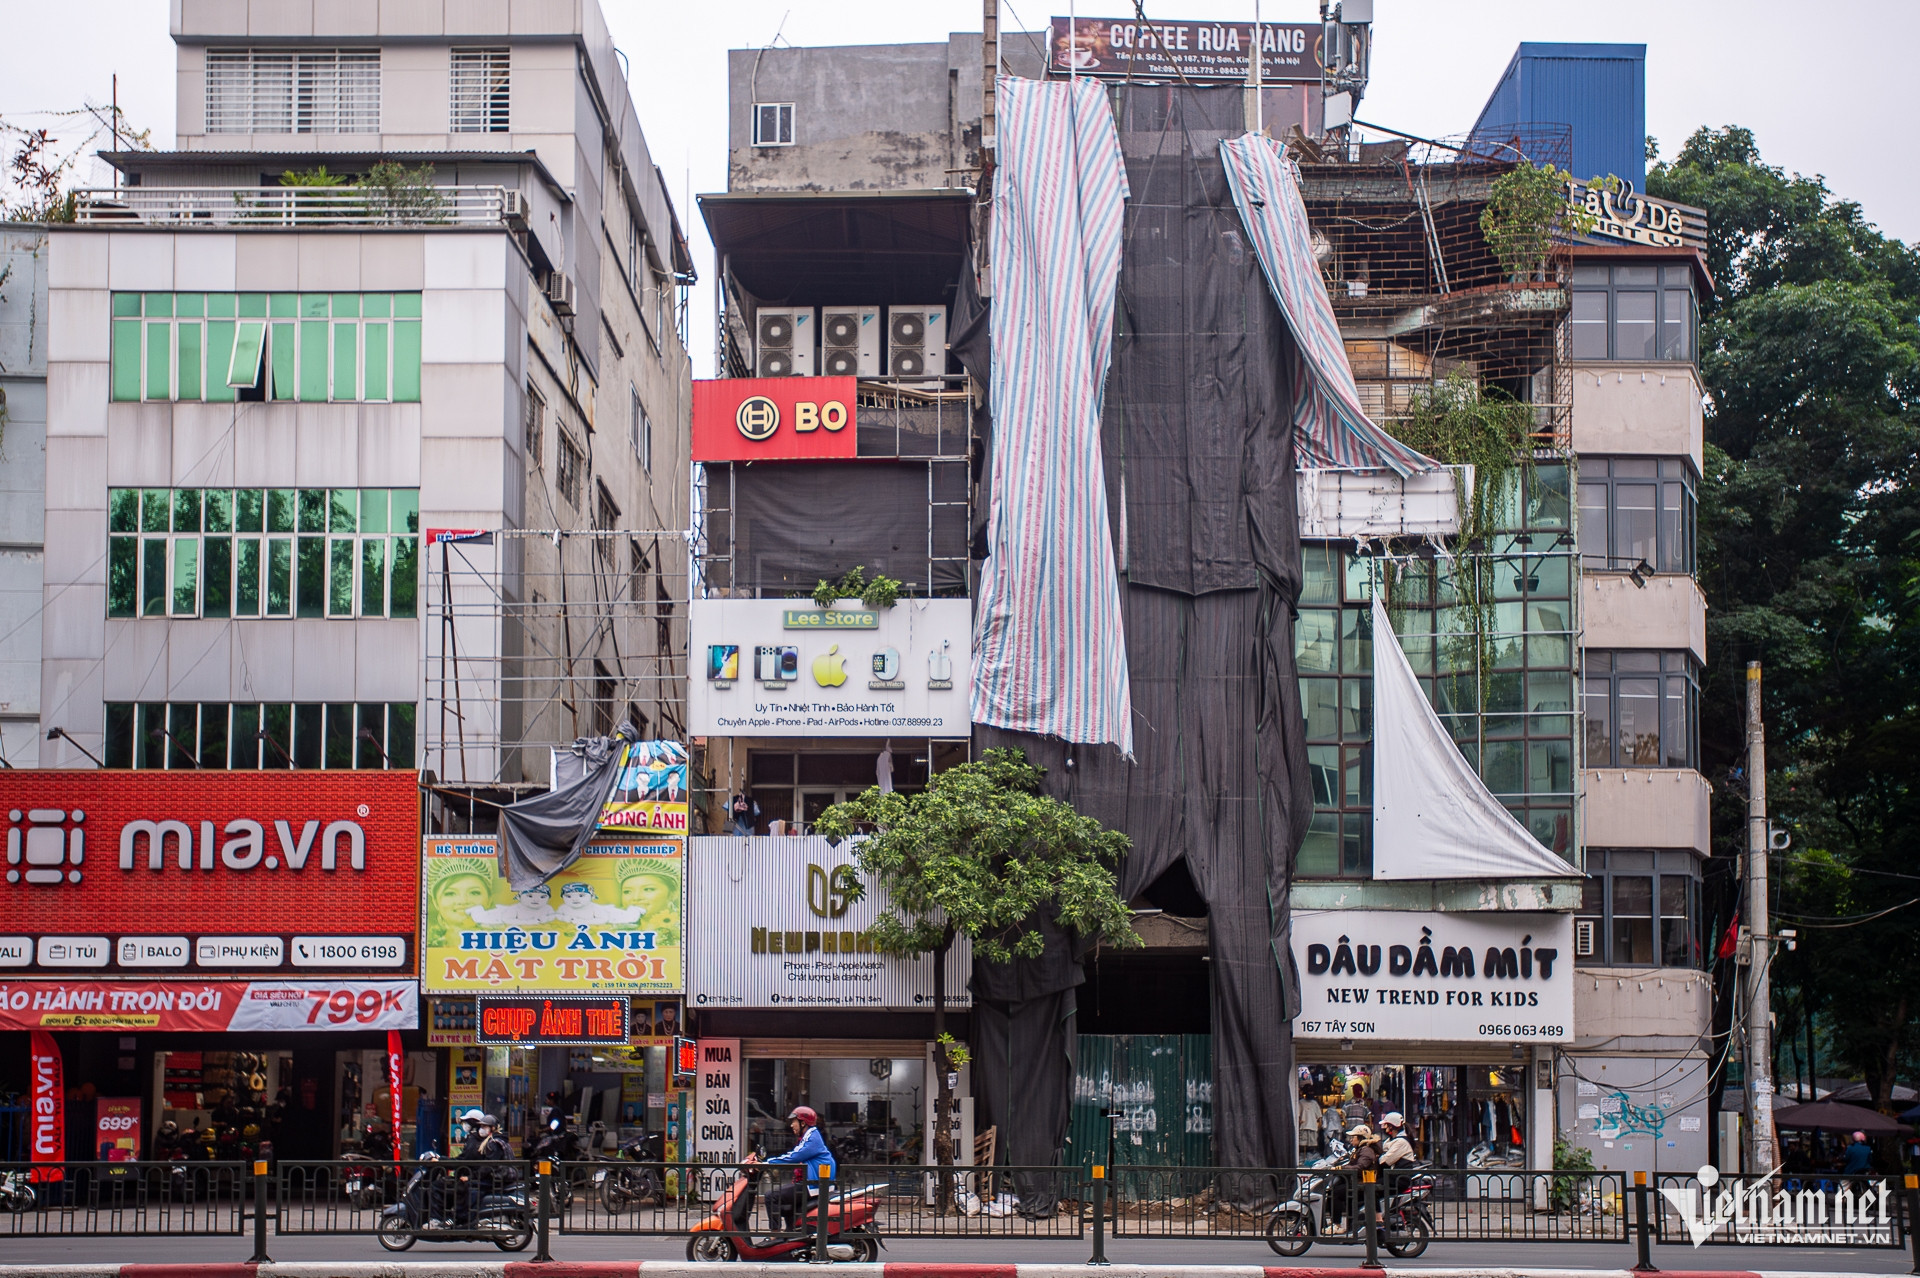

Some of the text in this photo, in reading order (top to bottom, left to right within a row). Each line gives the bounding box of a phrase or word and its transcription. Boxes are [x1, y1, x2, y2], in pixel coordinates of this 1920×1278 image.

[1110, 24, 1189, 50] COFFEE
[1198, 23, 1241, 52] RÙA
[1647, 202, 1683, 235] Dê
[795, 400, 848, 432] BO
[787, 611, 874, 627] Lee Store
[870, 681, 886, 689] Apple
[755, 703, 768, 714] Uy
[788, 703, 810, 713] Nhiệt
[811, 703, 830, 712] Tình
[836, 703, 855, 712] Bảo
[856, 703, 878, 712] Hành
[880, 702, 895, 712] Tốt
[717, 717, 747, 728] Chuyên
[748, 718, 770, 728] Apple
[776, 718, 801, 726] iPhone
[806, 718, 823, 726] iPad
[828, 718, 858, 726] AirPods
[892, 718, 943, 727] 037.88999.23
[652, 806, 686, 829] ẢNH
[119, 819, 366, 871] mia.vn
[436, 842, 676, 856] HỆ THỐNG CHUYÊN NGHIỆP
[460, 924, 656, 954] HIỆU ẢNH
[0, 947, 22, 958] ALI
[148, 946, 182, 957] BALO
[222, 944, 279, 959] PHỤ KIỆN
[320, 946, 397, 958] 1800 6198
[1308, 925, 1558, 980] DÂU DẦM MÍT
[444, 952, 666, 984] MẶT TRỜI
[32, 986, 105, 1011] HÀNH
[110, 990, 175, 1015] TRỌN
[178, 986, 221, 1011] ĐỜI
[306, 989, 405, 1025] 799K
[1327, 988, 1539, 1007] NEW TREND FOR KIDS
[483, 1000, 622, 1041] CHỤP ẢNH THẺ
[1301, 1019, 1564, 1037] 167 TÂY SƠN 0966 063 489
[705, 1047, 732, 1062] MUA
[706, 1070, 731, 1088] BÁN
[705, 1094, 731, 1115] SỬA
